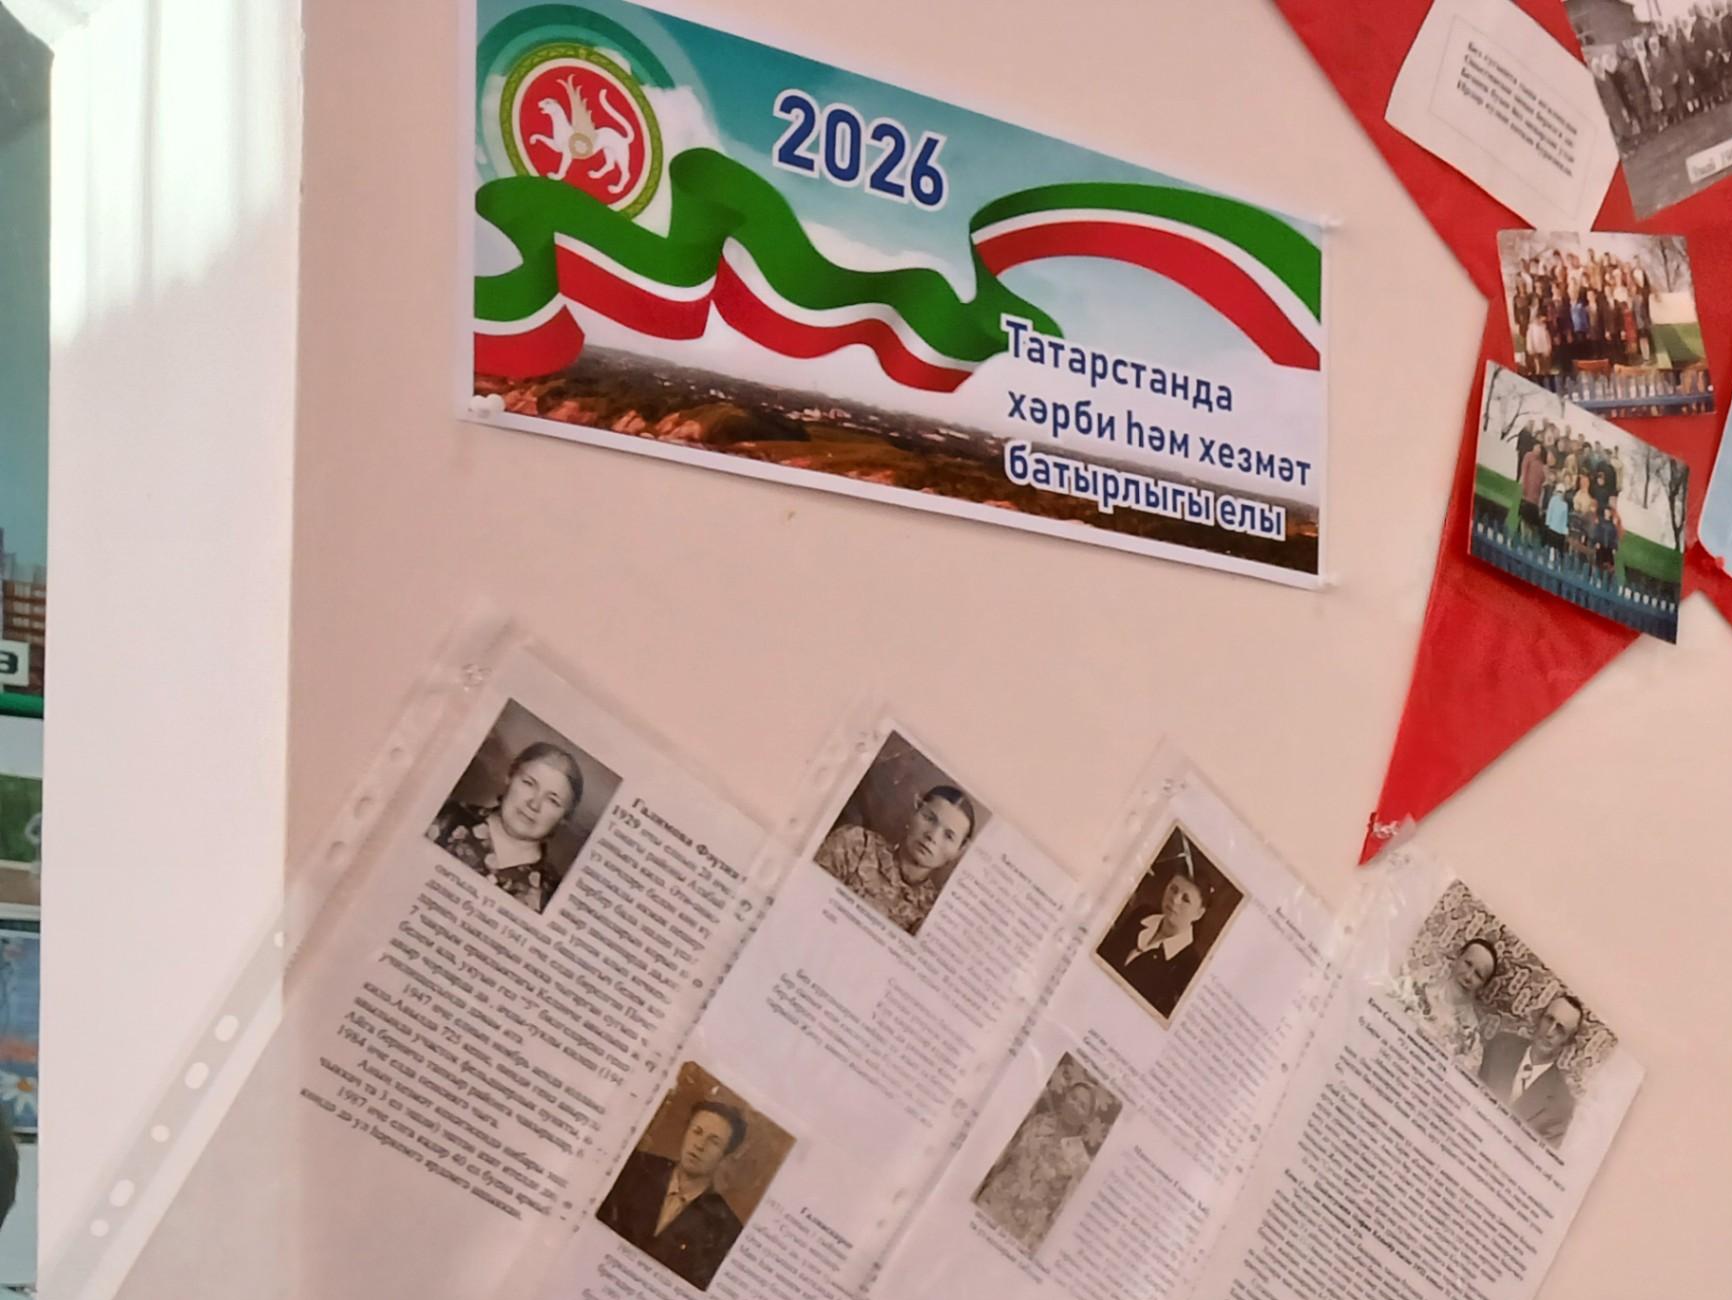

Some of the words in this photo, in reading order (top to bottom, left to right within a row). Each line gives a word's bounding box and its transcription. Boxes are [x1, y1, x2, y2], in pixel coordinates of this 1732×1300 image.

[776, 94, 945, 206] 2026
[1005, 319, 1233, 412] Татарстанда
[1007, 390, 1116, 441] хәрби
[1126, 409, 1190, 458] һәм
[1199, 436, 1312, 486] хезмәт
[1008, 444, 1211, 521] батырлыгы
[1219, 499, 1283, 537] елы
